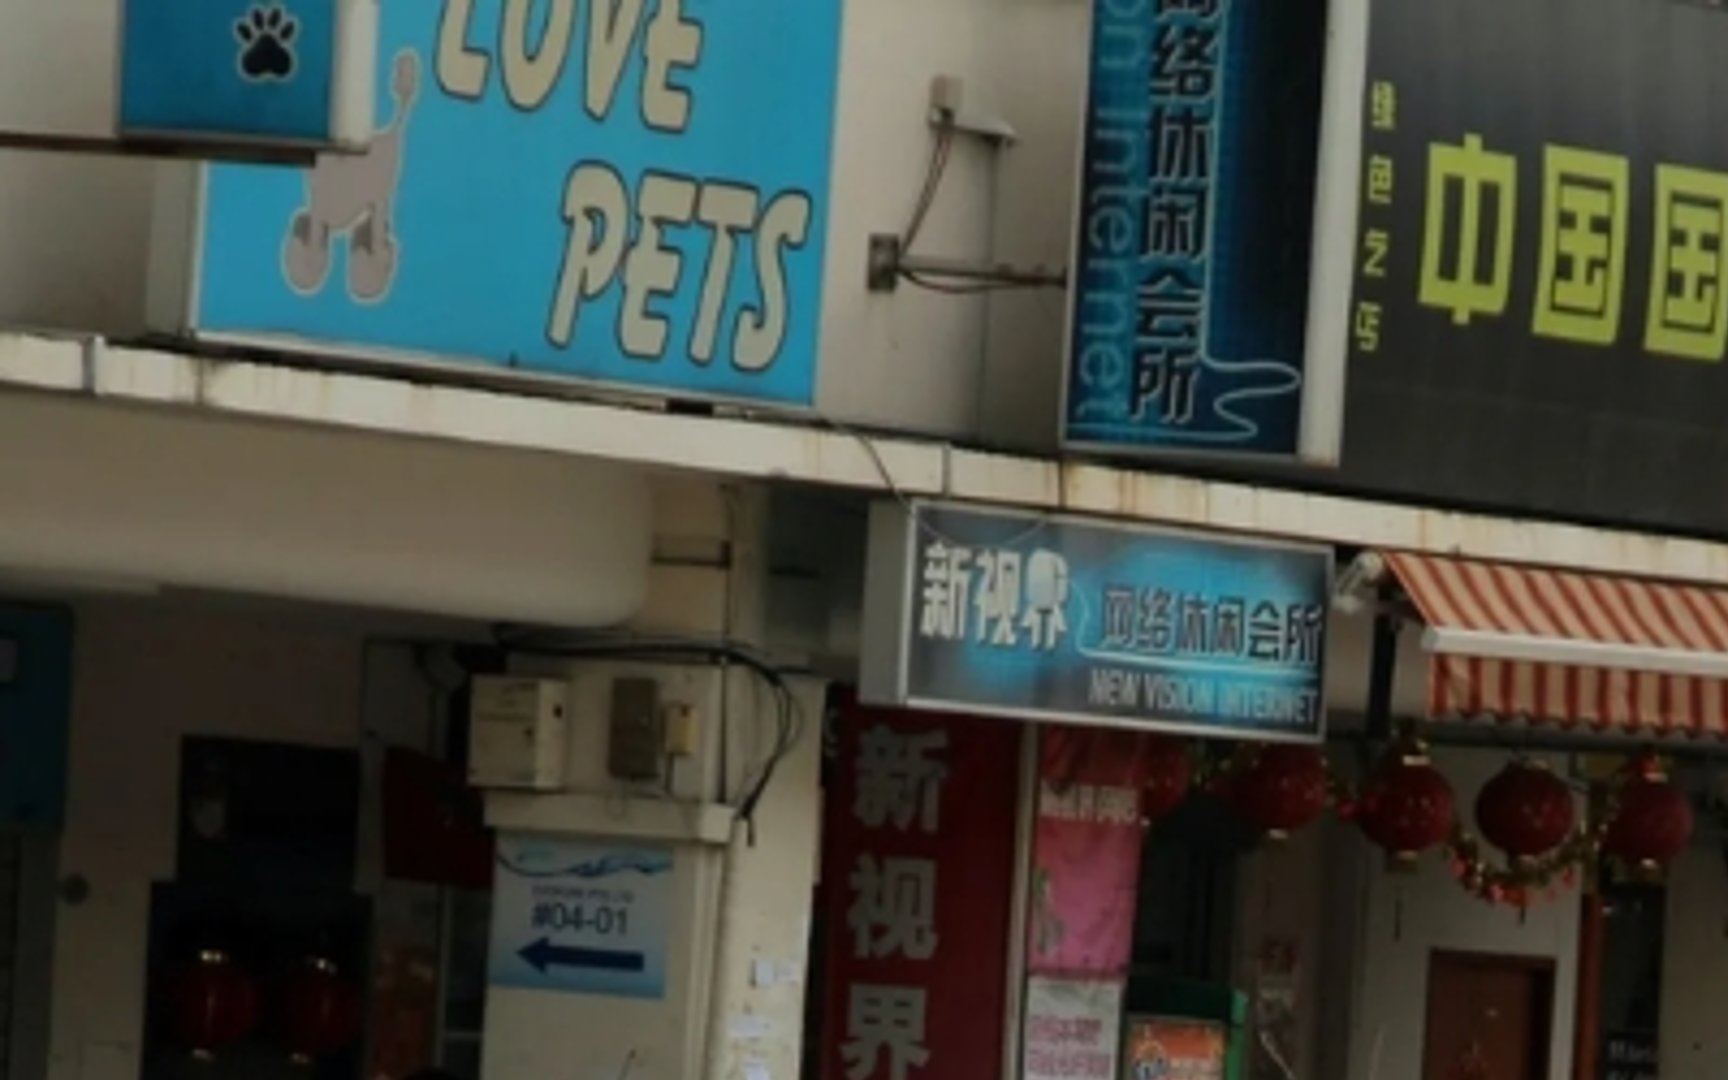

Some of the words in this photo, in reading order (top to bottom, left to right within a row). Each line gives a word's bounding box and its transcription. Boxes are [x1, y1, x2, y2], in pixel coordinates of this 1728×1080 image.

[432, 0, 704, 133] LOVE
[546, 159, 813, 372] PETS
[1128, 0, 1225, 424] 络休闲会所
[920, 539, 1070, 652] 新视界
[1102, 582, 1321, 666] 网络休闲会所
[1088, 668, 1141, 707] NEW
[1143, 672, 1215, 715] VISION
[1221, 682, 1318, 723] INTERNET
[531, 902, 629, 936] #04-01
